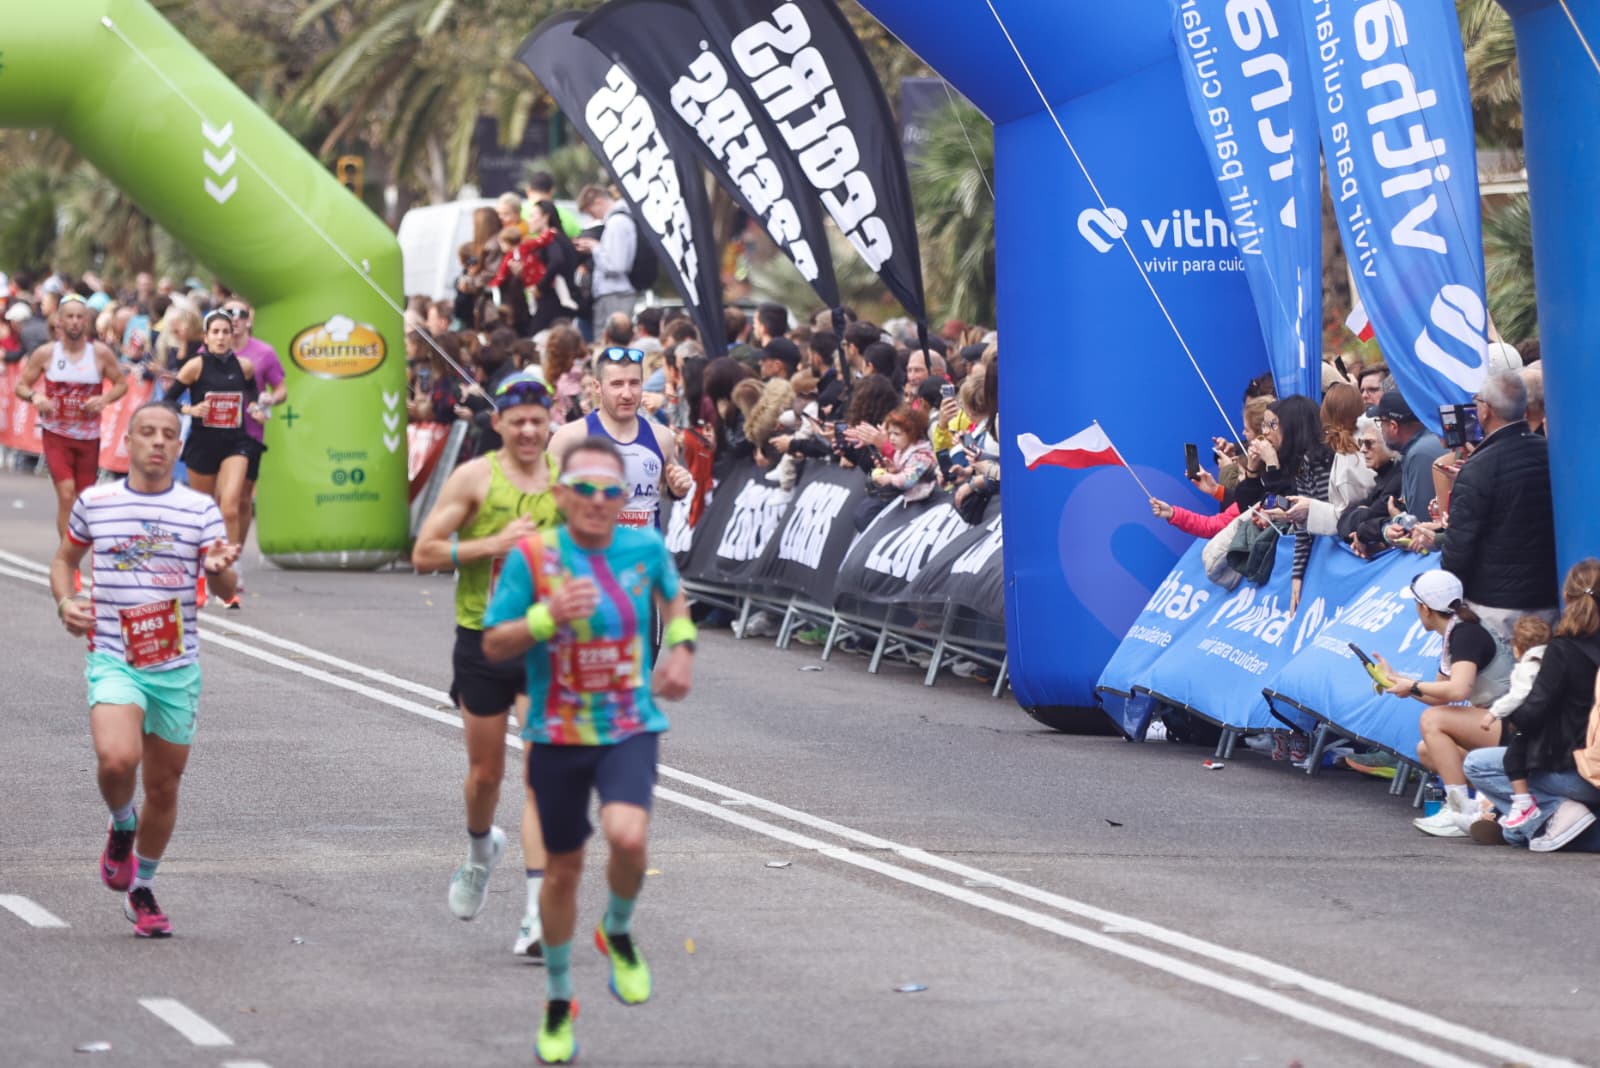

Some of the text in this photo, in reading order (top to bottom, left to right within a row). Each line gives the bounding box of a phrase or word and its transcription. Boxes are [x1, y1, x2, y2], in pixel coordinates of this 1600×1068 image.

[1140, 209, 1238, 249] vith
[1144, 257, 1179, 273] vivir
[1182, 260, 1217, 276] para
[299, 342, 379, 359] Gourmet
[131, 616, 164, 635] 2463
